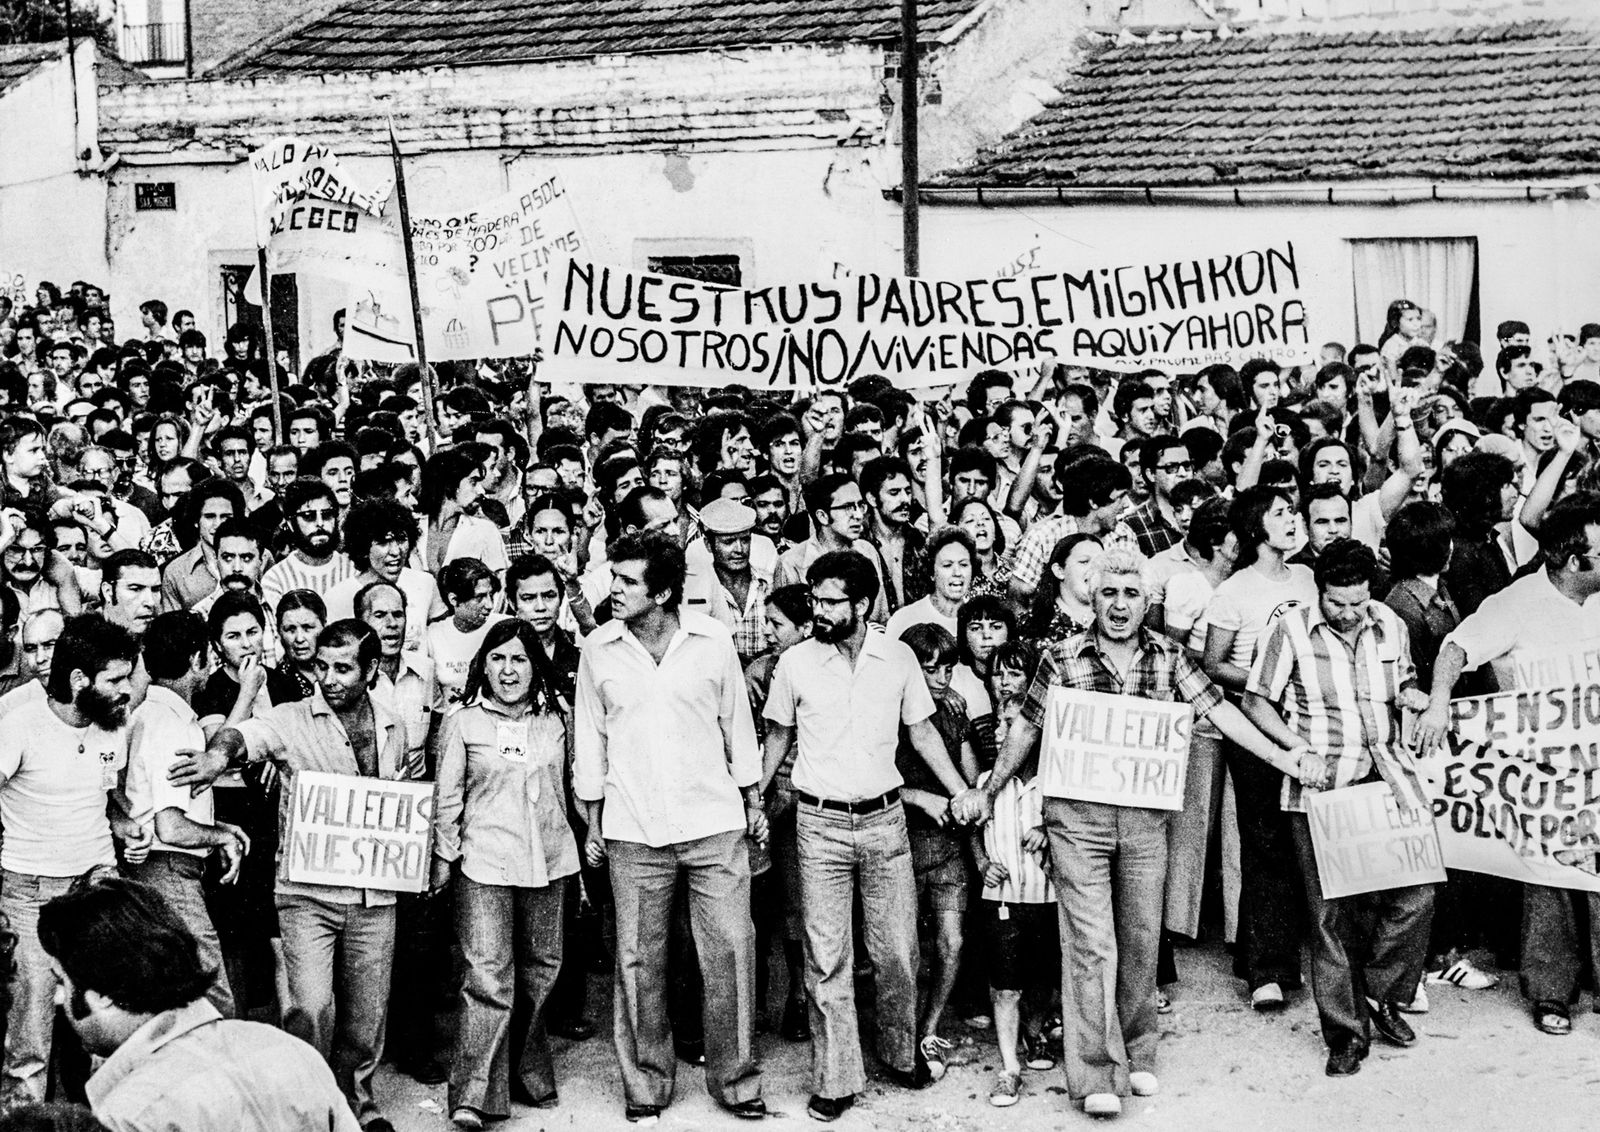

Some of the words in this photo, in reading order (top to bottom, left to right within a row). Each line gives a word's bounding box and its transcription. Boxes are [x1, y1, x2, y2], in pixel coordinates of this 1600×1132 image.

[564, 258, 842, 328] NUESTROS
[553, 320, 770, 374] NOSOTROS
[1054, 700, 1191, 754] VALLECAS
[1049, 746, 1180, 798] NUESTRO
[299, 783, 433, 835] VALLECAS
[291, 831, 424, 880] NUESTRO
